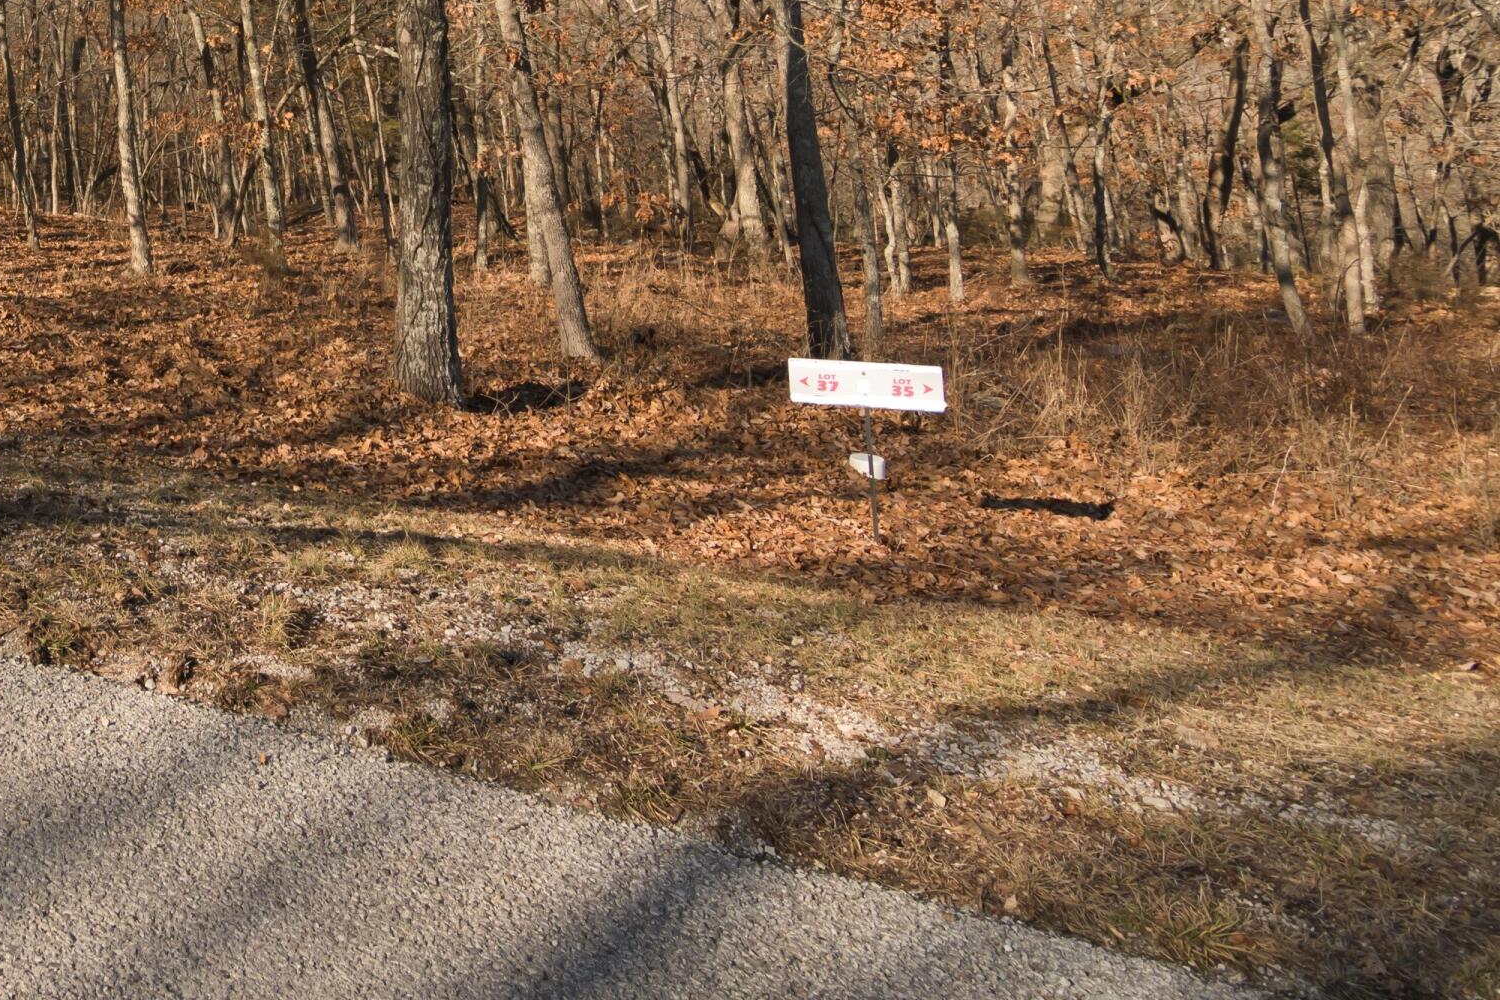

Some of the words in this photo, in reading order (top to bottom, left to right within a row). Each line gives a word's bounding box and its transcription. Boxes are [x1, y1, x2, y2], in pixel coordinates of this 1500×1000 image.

[817, 380, 839, 392] 37
[893, 378, 912, 386] LOT
[891, 385, 914, 397] 35
